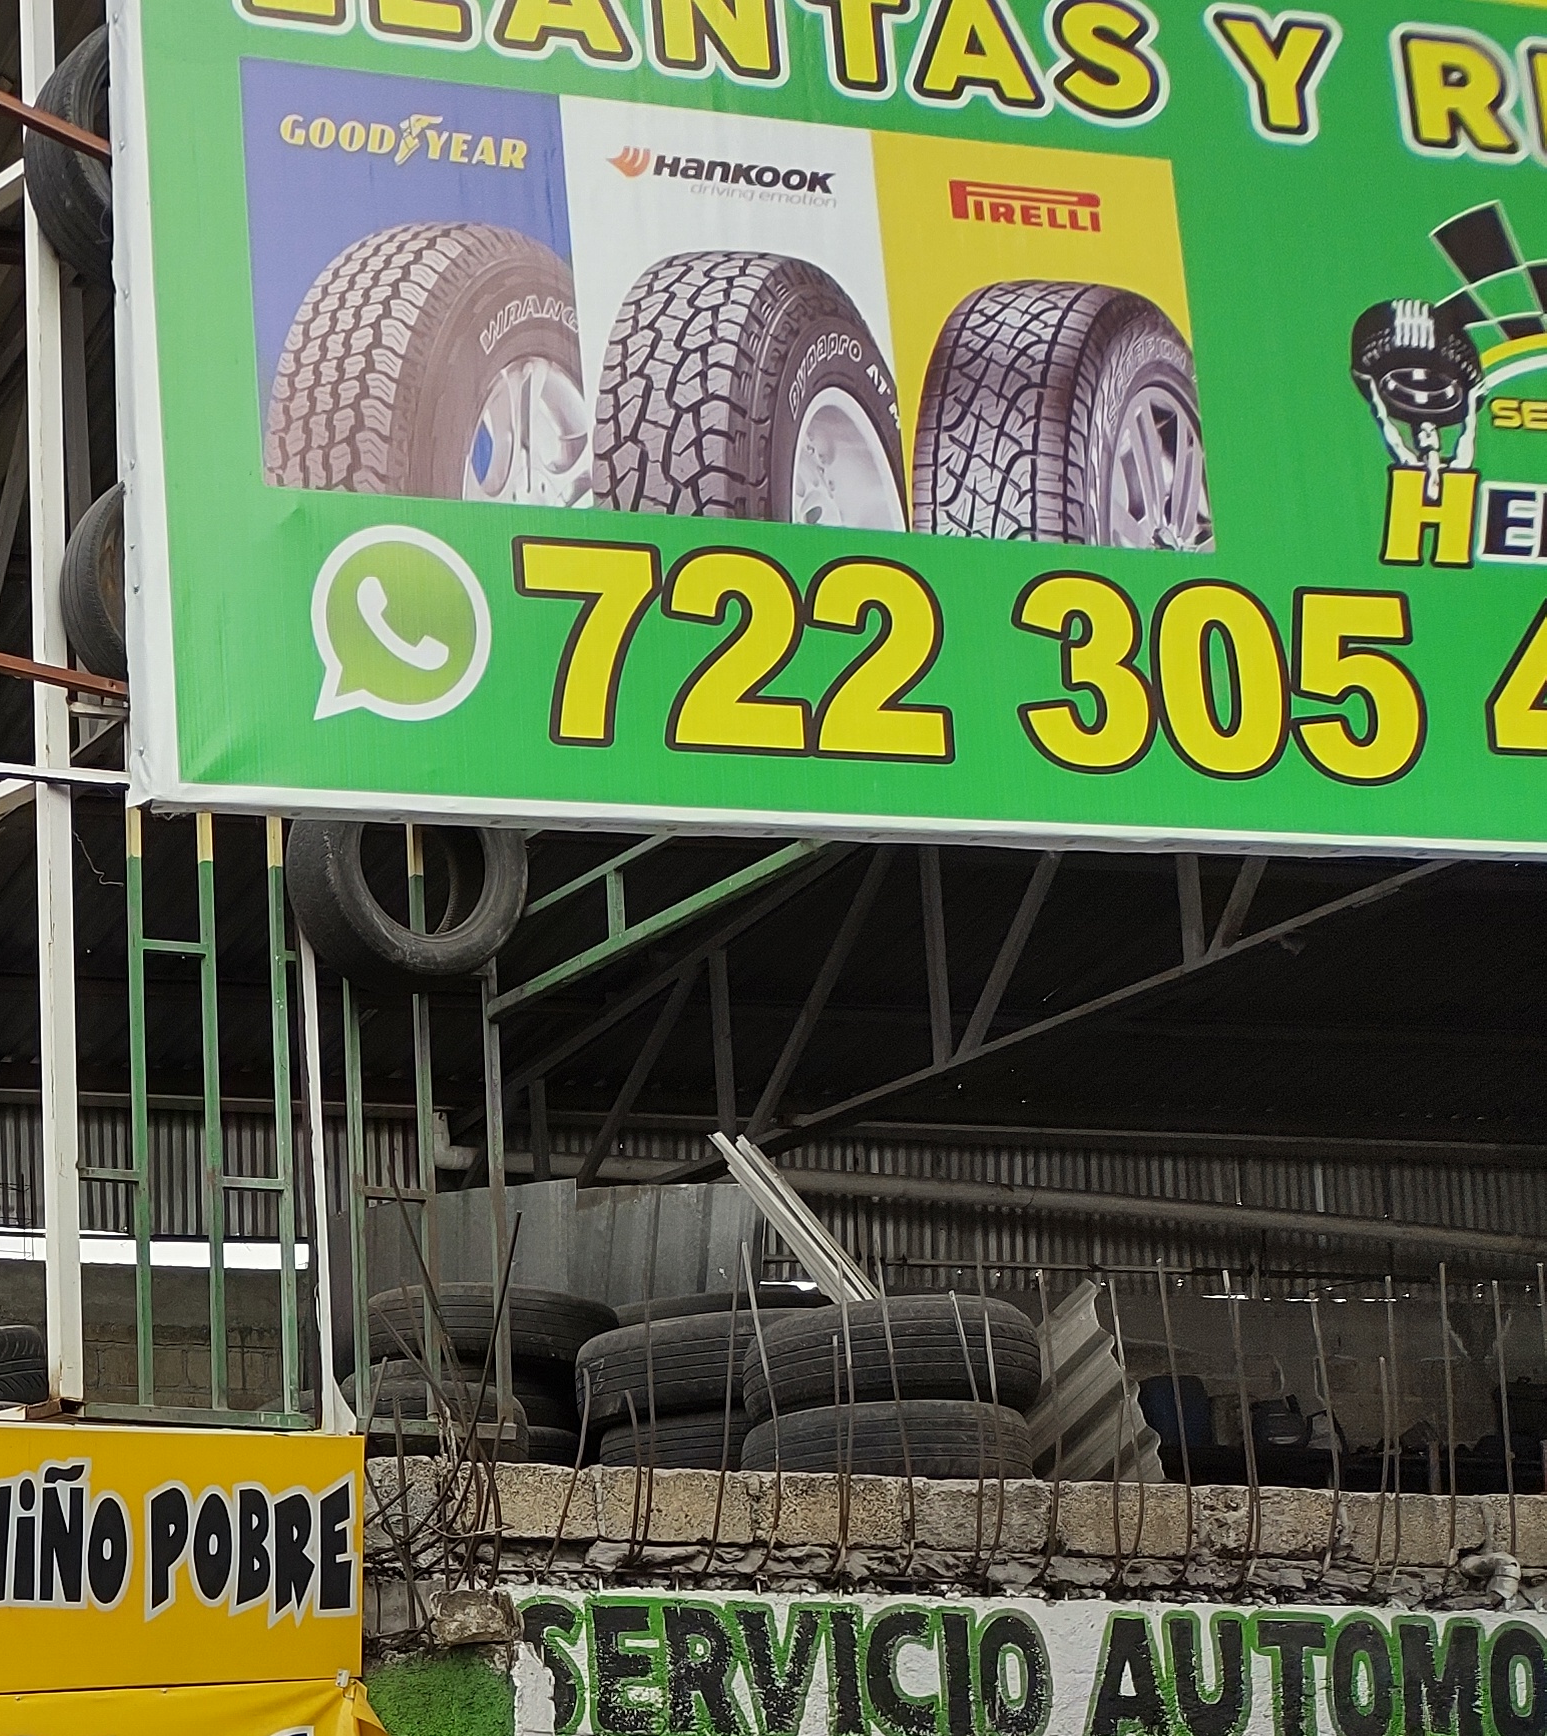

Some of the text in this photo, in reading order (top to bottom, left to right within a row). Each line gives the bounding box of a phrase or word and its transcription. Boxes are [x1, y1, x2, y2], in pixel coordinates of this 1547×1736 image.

[235, 0, 1165, 122] ANTAS
[1209, 6, 1337, 140] Y
[690, 182, 837, 210] driving emotion
[948, 179, 1102, 232] PIRELLI
[1379, 464, 1547, 569] HE
[511, 534, 953, 763] 722
[1012, 570, 1427, 786] 305
[146, 1472, 357, 1623] POBRE
